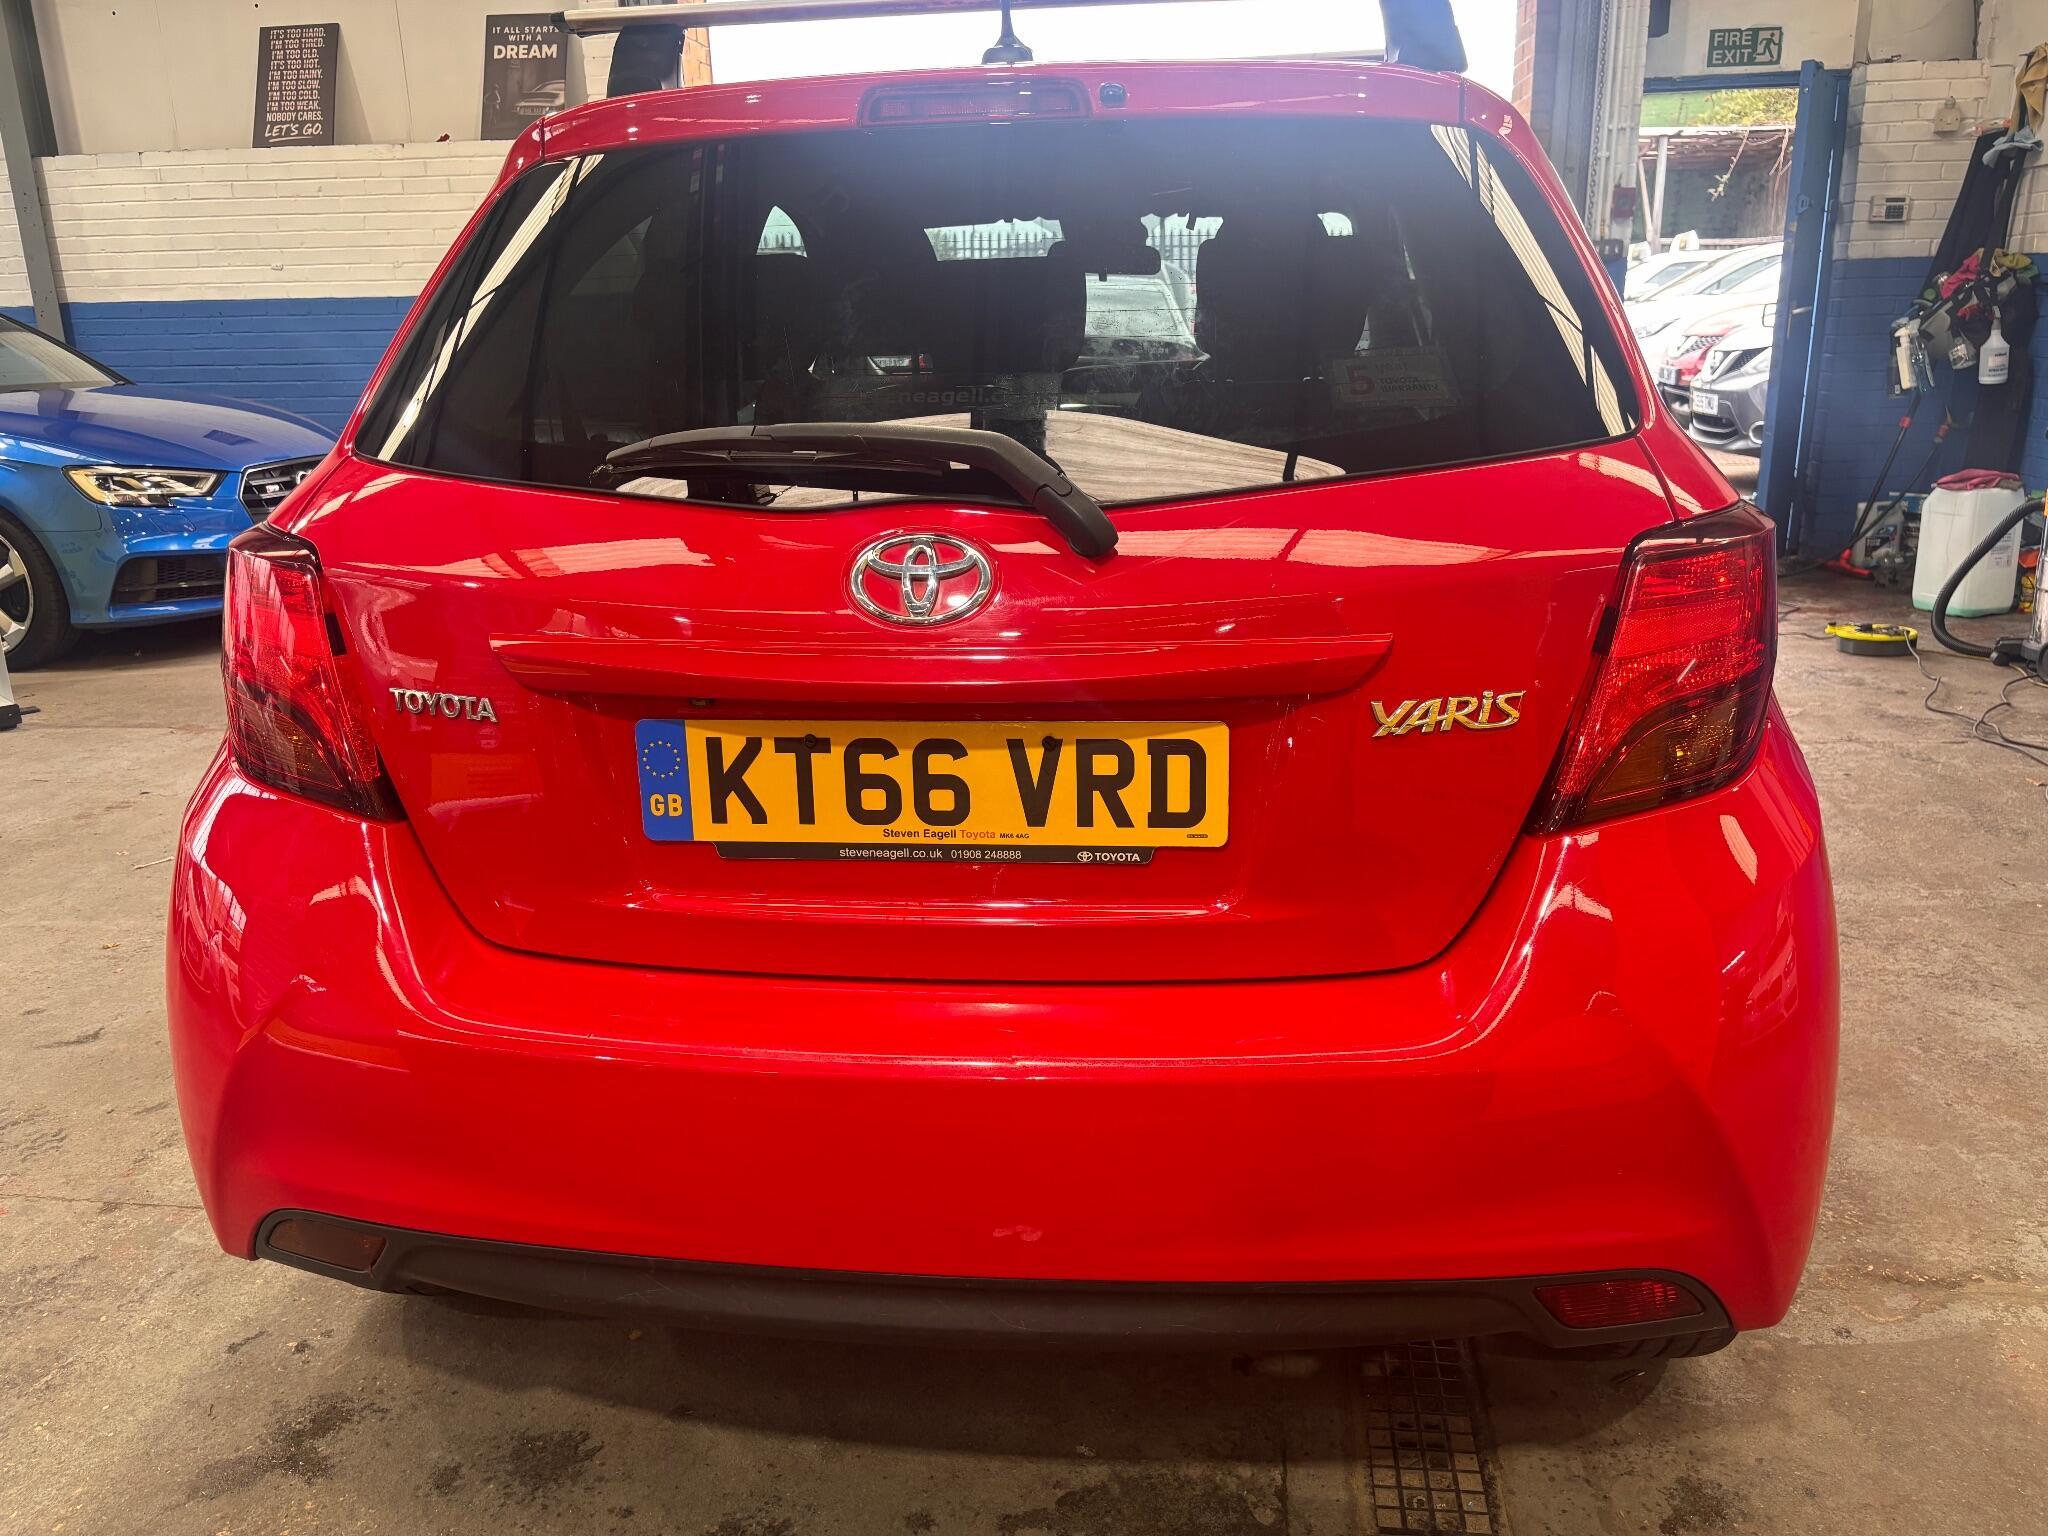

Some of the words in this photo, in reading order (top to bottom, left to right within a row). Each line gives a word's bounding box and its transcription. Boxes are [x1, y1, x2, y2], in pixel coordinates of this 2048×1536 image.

[270, 30, 285, 39] IT'S
[287, 29, 301, 38] TOO
[303, 28, 326, 37] HARD.
[1714, 31, 1752, 46] FIRE
[270, 40, 282, 49] I'M
[285, 40, 299, 48] TOO
[301, 38, 325, 47] TIRED.
[272, 50, 283, 60] I'M
[286, 50, 300, 59] TOO
[302, 49, 319, 58] OLD.
[494, 44, 558, 59] DREAM
[1712, 49, 1752, 64] EXIT
[271, 60, 285, 70] IT'S
[287, 60, 301, 69] TOO
[303, 59, 320, 68] HOT.
[269, 71, 280, 80] I'M
[283, 70, 297, 79] TOO
[300, 69, 323, 79] RAINY.
[268, 81, 279, 90] I'M
[282, 81, 296, 90] TOO
[298, 80, 320, 89] SLOW.
[268, 92, 279, 100] I'M
[282, 91, 296, 100] TOO
[299, 90, 320, 99] COLD.
[267, 102, 278, 111] I'M
[280, 101, 295, 110] TOO
[297, 101, 320, 110] WEAK.
[266, 112, 296, 121] NOBODY
[298, 111, 323, 120] CARES.
[265, 123, 299, 137] LET'S
[303, 123, 322, 135] GO.
[1346, 364, 1375, 395] 5
[389, 688, 498, 722] TOYOTA
[706, 737, 970, 826] KT66
[1007, 738, 1208, 829] VRD
[650, 794, 683, 817] GB
[883, 829, 920, 838] Steven
[923, 829, 957, 840] Eagell
[960, 829, 996, 840] Toyota
[839, 848, 943, 860] steveneagell.co.uk
[951, 850, 982, 859] 01908
[985, 850, 1022, 859] 248888
[1095, 853, 1140, 862] TOYOTA
